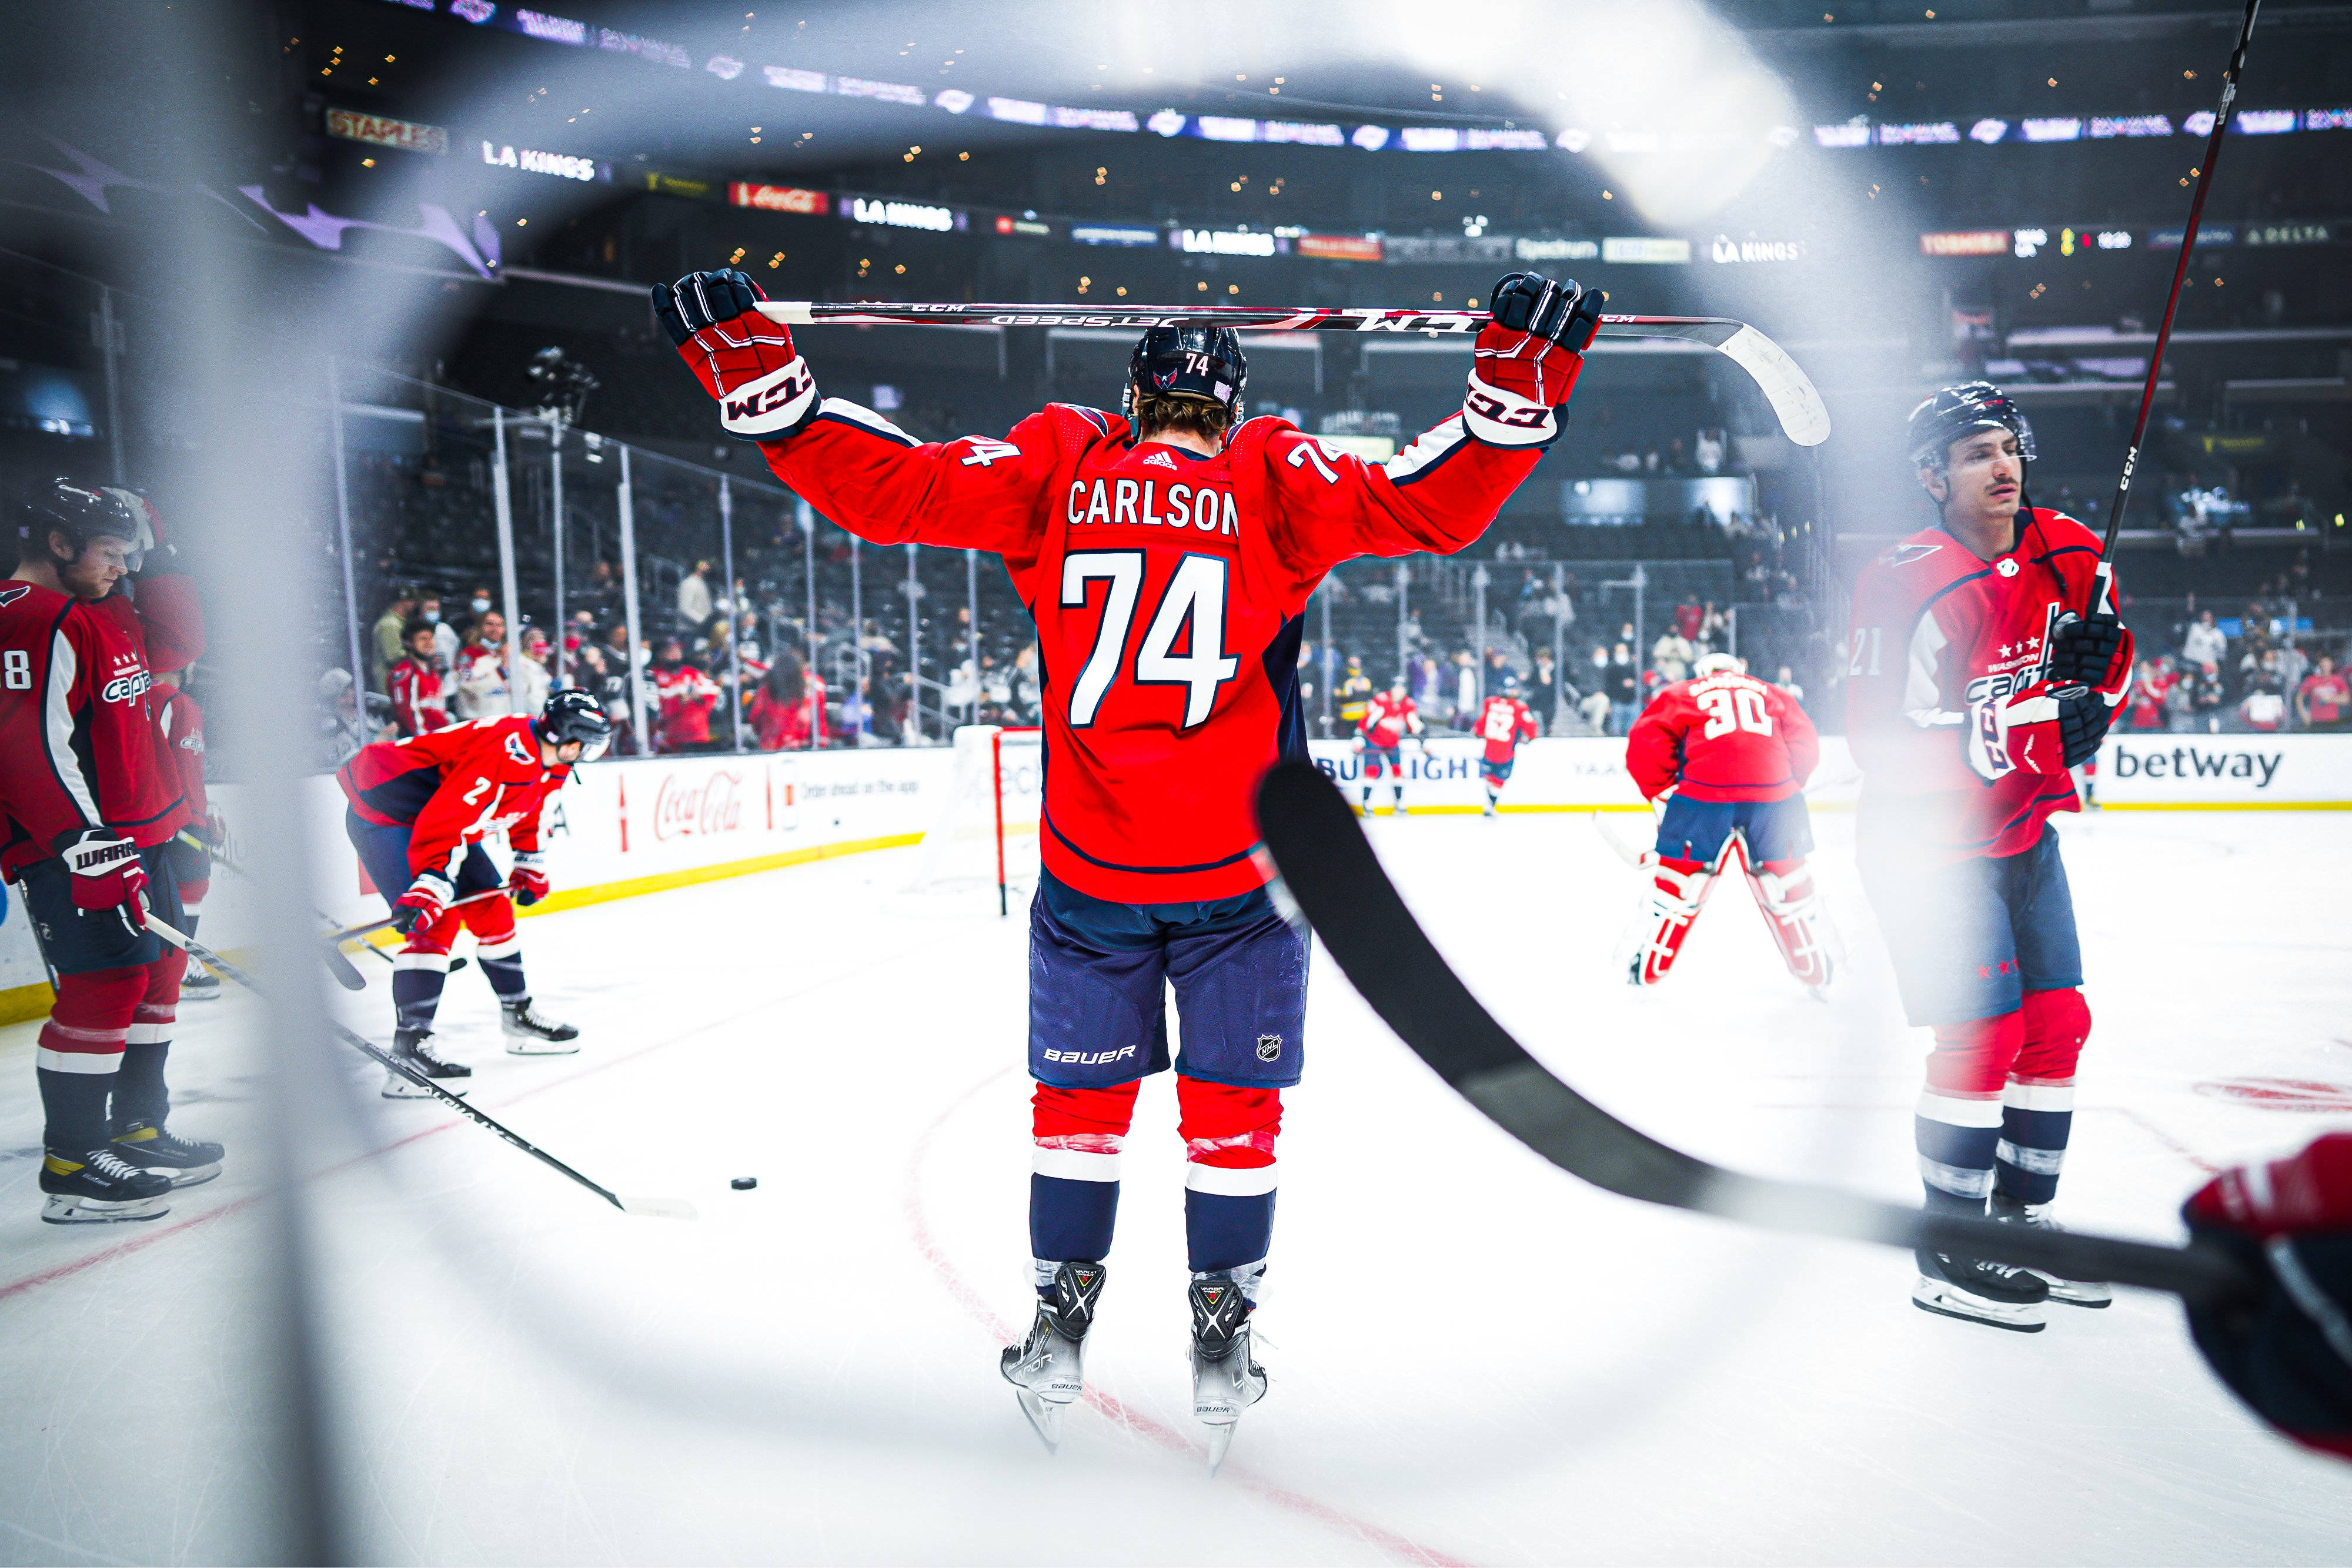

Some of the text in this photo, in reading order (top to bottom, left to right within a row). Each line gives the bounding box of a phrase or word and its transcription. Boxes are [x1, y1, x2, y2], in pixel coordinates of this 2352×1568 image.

[329, 109, 445, 153] STAPLES
[482, 141, 594, 182] LA KINGS
[1712, 240, 1739, 263] LA
[1742, 241, 1799, 262] KINGS
[911, 304, 965, 312] CCM
[991, 315, 1190, 328] JETSPEED
[1356, 315, 1476, 333] CM
[1598, 315, 1636, 323] CM
[1185, 353, 1209, 377] 74
[1466, 382, 1550, 429] CC
[1142, 459, 1178, 471] adidas
[2119, 445, 2137, 492] CCM
[1067, 478, 1239, 537] CARLSON
[1058, 547, 1241, 731] 74
[1849, 627, 1883, 676] 21
[1696, 688, 1773, 740] 30
[2115, 744, 2285, 788] betway
[462, 776, 492, 806] 2
[1043, 1045, 1137, 1065] BAUER
[419, 1085, 476, 1120] ALPHA
[1051, 1383, 1083, 1391] BAUER
